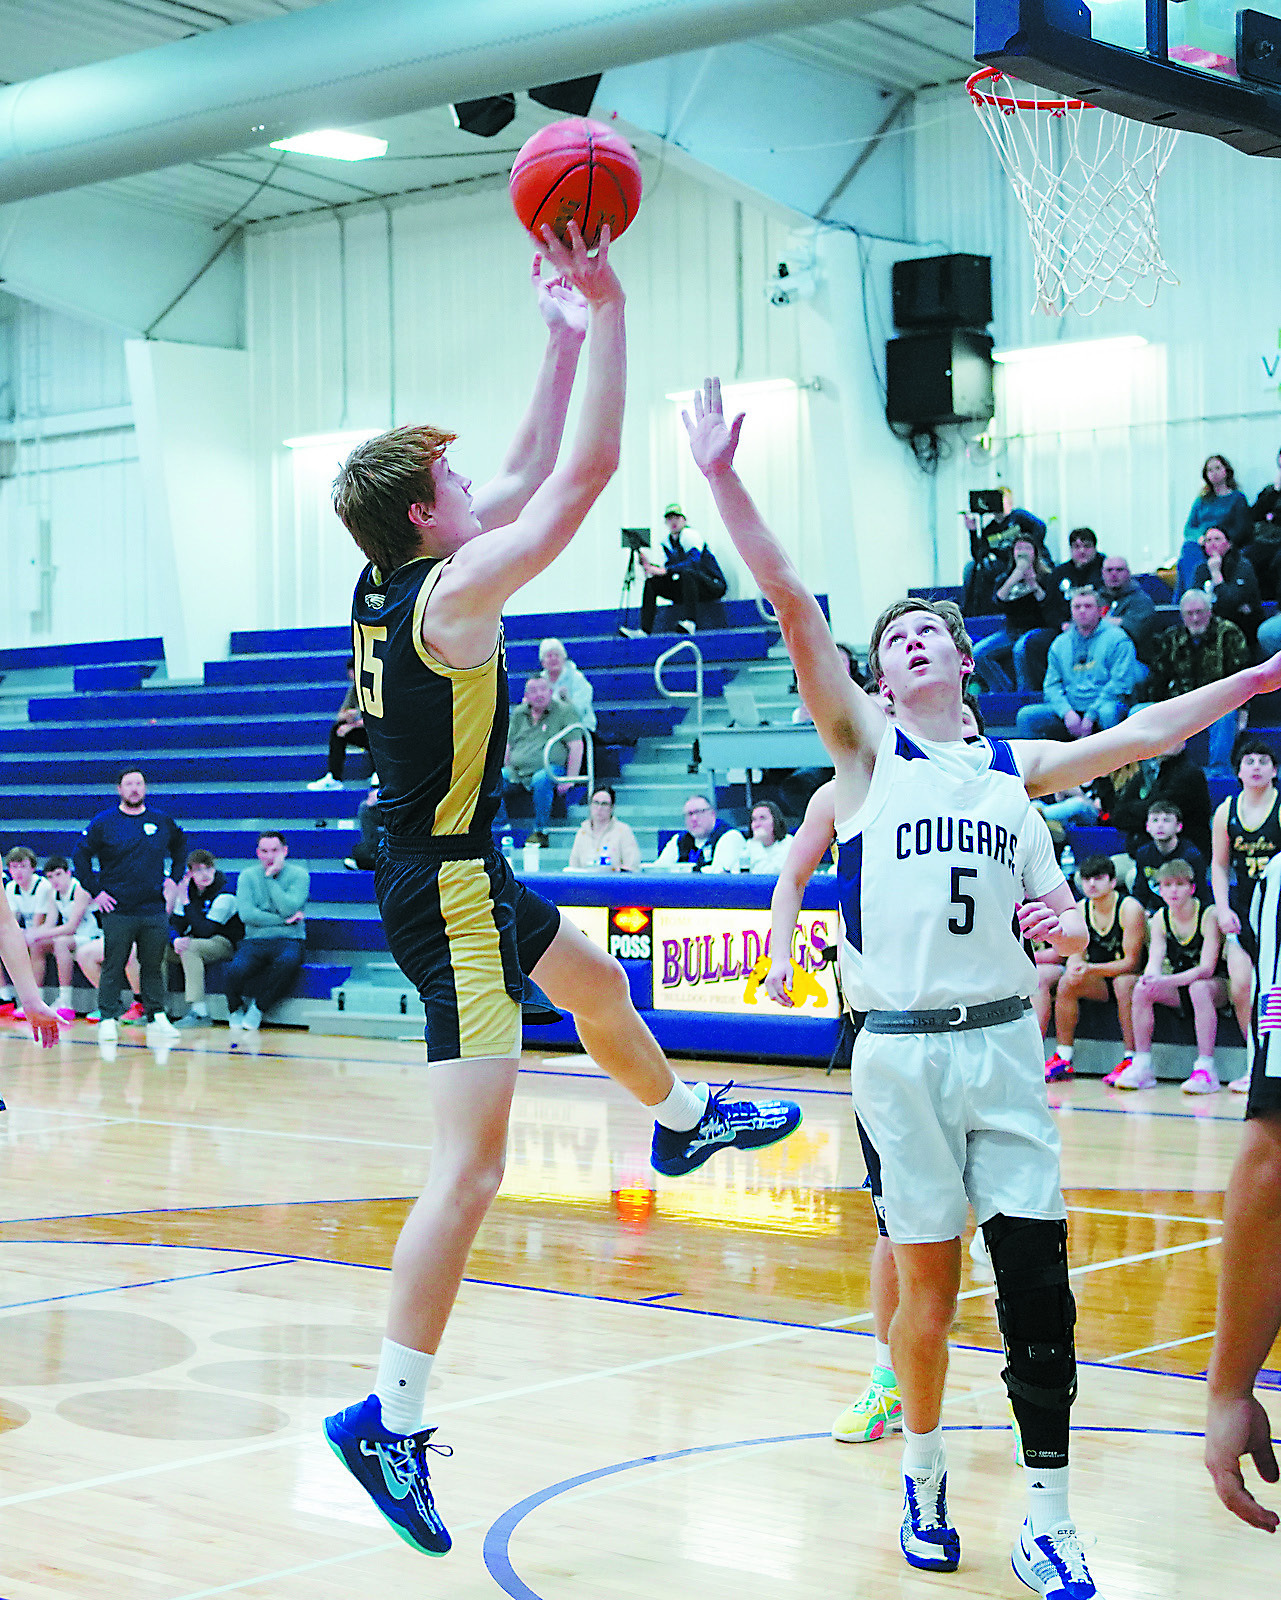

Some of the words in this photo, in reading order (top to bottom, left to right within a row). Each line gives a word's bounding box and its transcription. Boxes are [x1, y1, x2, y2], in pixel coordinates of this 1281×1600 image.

[896, 816, 1018, 877] COUGARS
[948, 866, 978, 936] 5
[610, 934, 651, 958] POSS
[662, 920, 829, 989] BULLDGS
